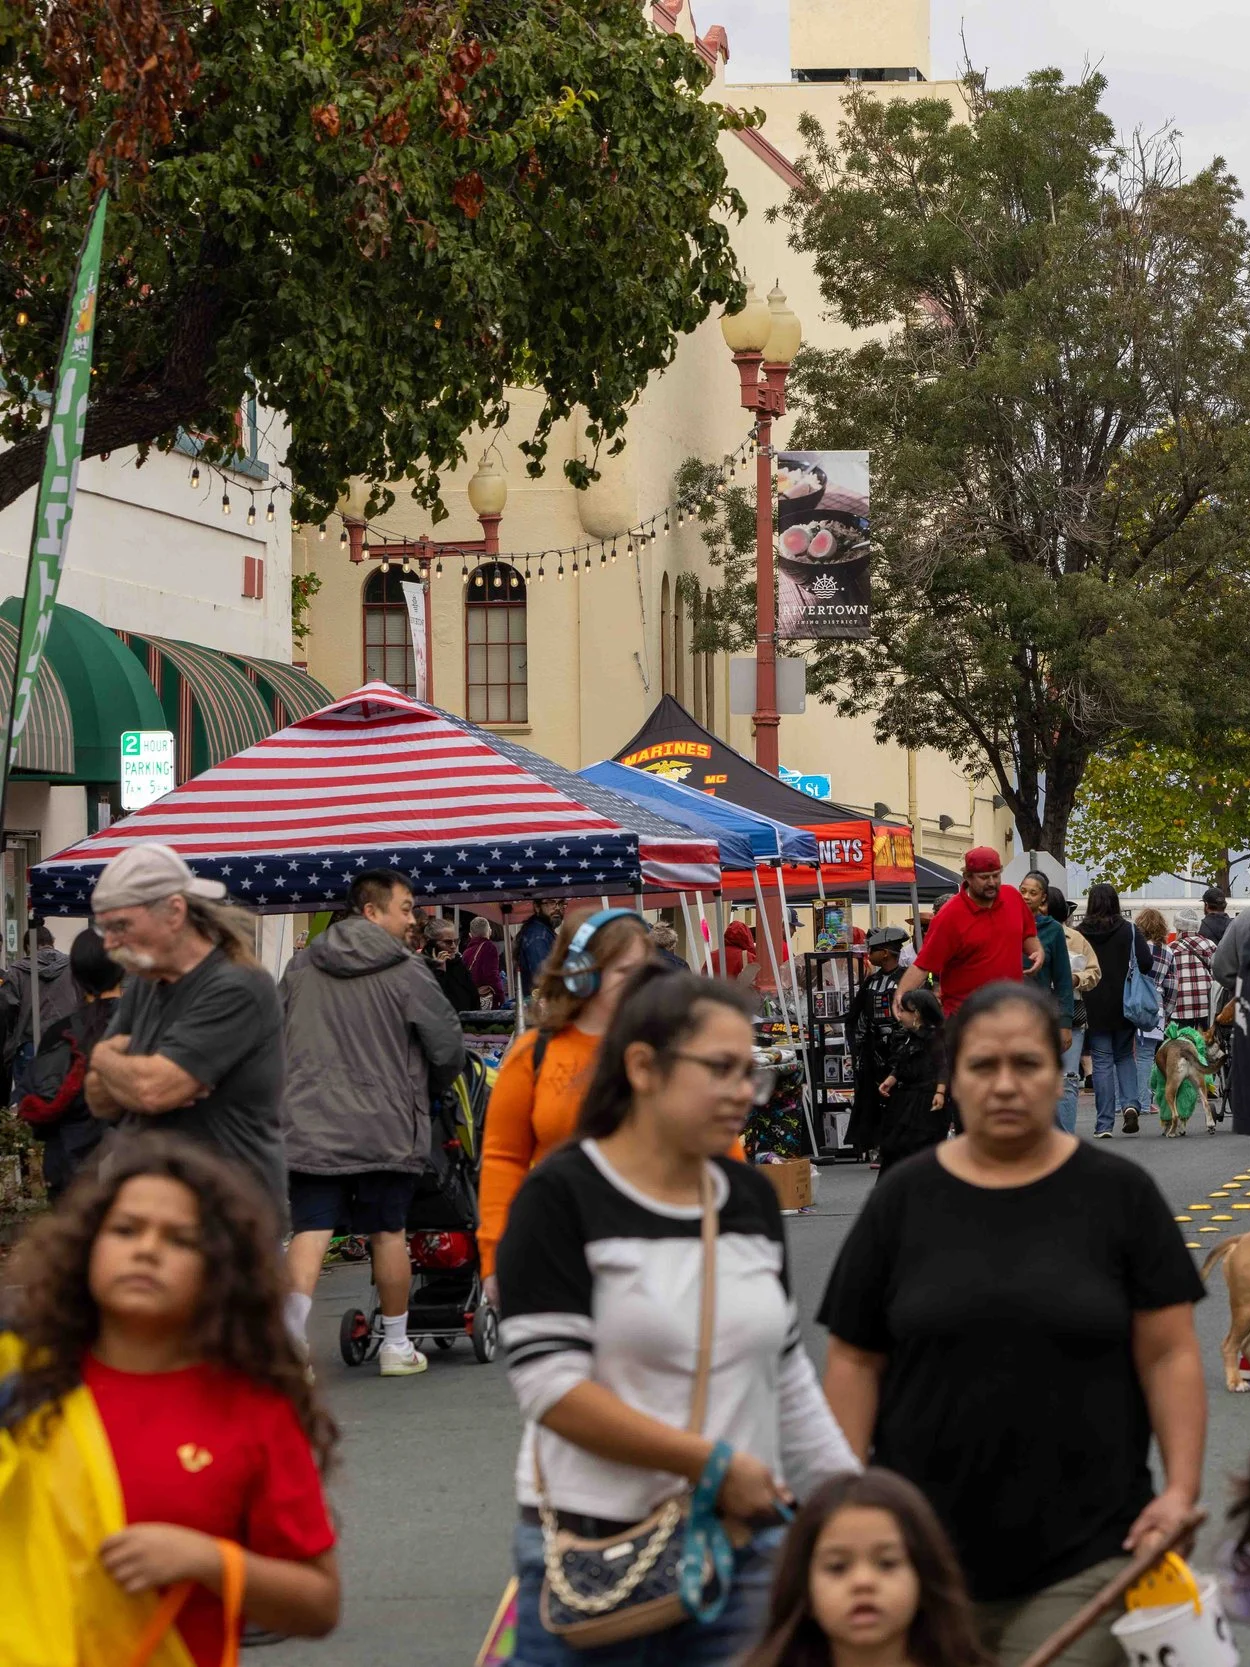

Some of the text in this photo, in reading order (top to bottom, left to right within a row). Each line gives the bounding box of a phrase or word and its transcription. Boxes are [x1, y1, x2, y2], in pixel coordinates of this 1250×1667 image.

[783, 604, 869, 615] RIVERTOWN
[125, 735, 168, 753] 2 HOUR
[623, 740, 710, 766] MARINES
[125, 761, 170, 776] PARKING
[704, 775, 728, 784] MC
[805, 782, 820, 797] St
